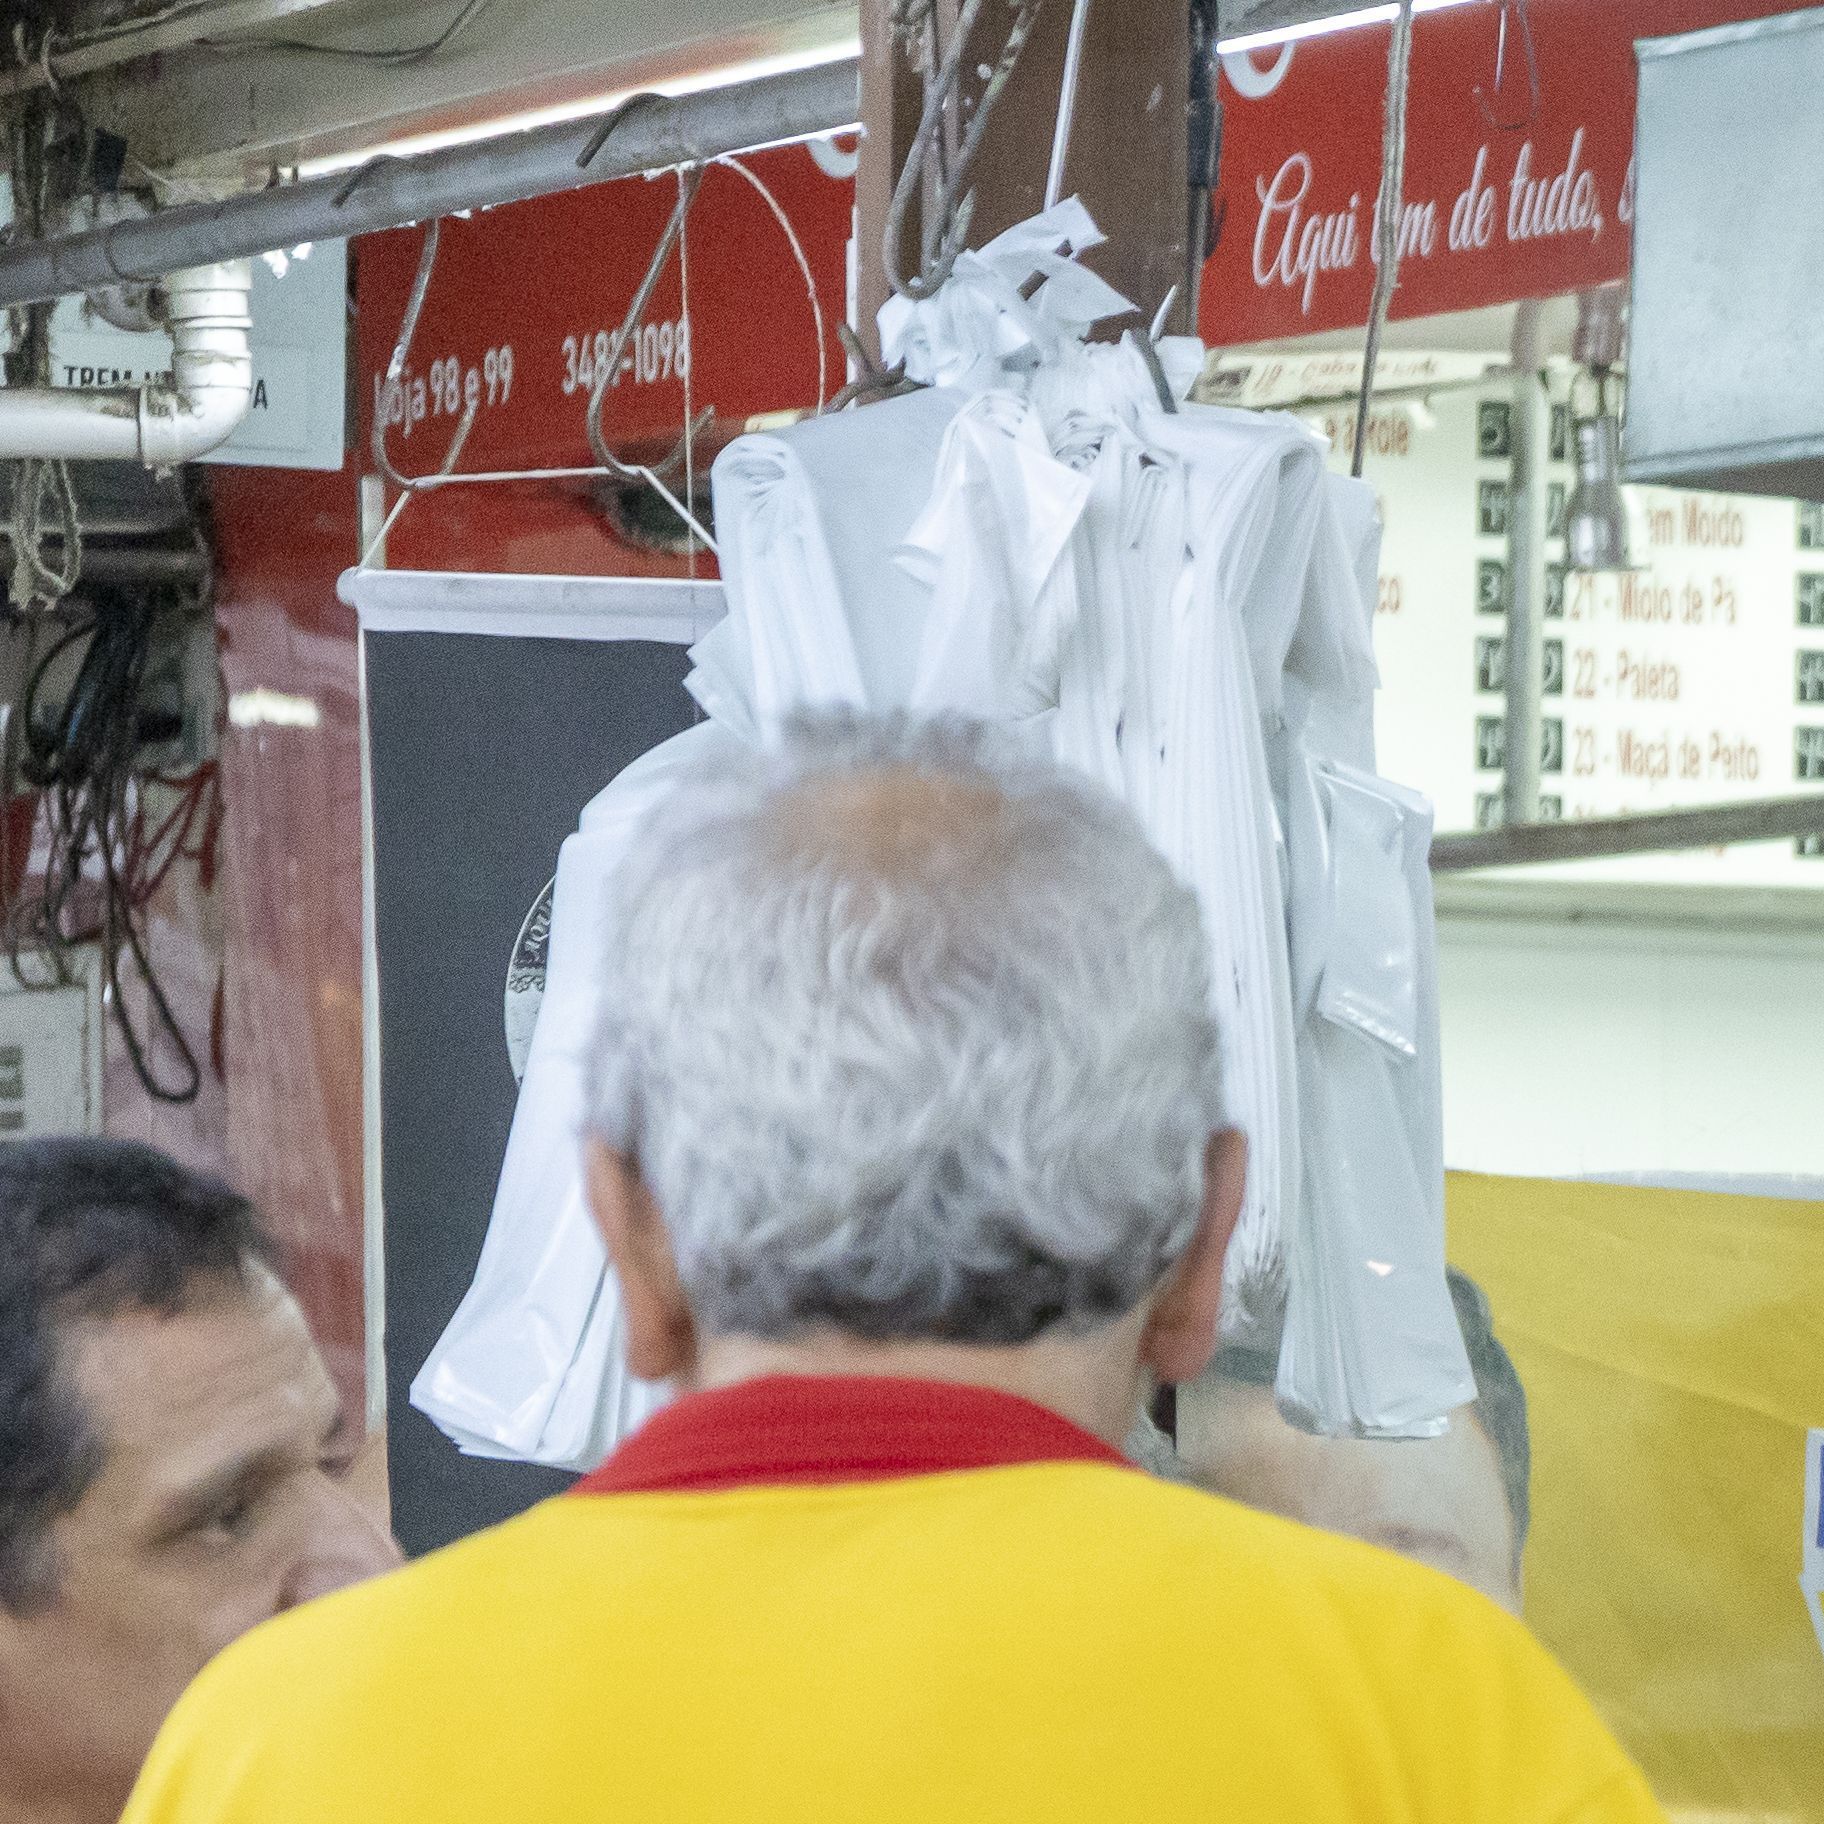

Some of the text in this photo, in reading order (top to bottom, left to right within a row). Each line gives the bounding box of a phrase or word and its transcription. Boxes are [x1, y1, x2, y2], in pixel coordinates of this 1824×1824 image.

[1252, 151, 1360, 317] Aqui
[1447, 144, 1496, 252] de
[430, 356, 461, 415] 98
[484, 345, 514, 406] 99
[1573, 648, 1597, 700] 22
[1616, 647, 1682, 702] Paleta
[1708, 728, 1760, 781] Peito
